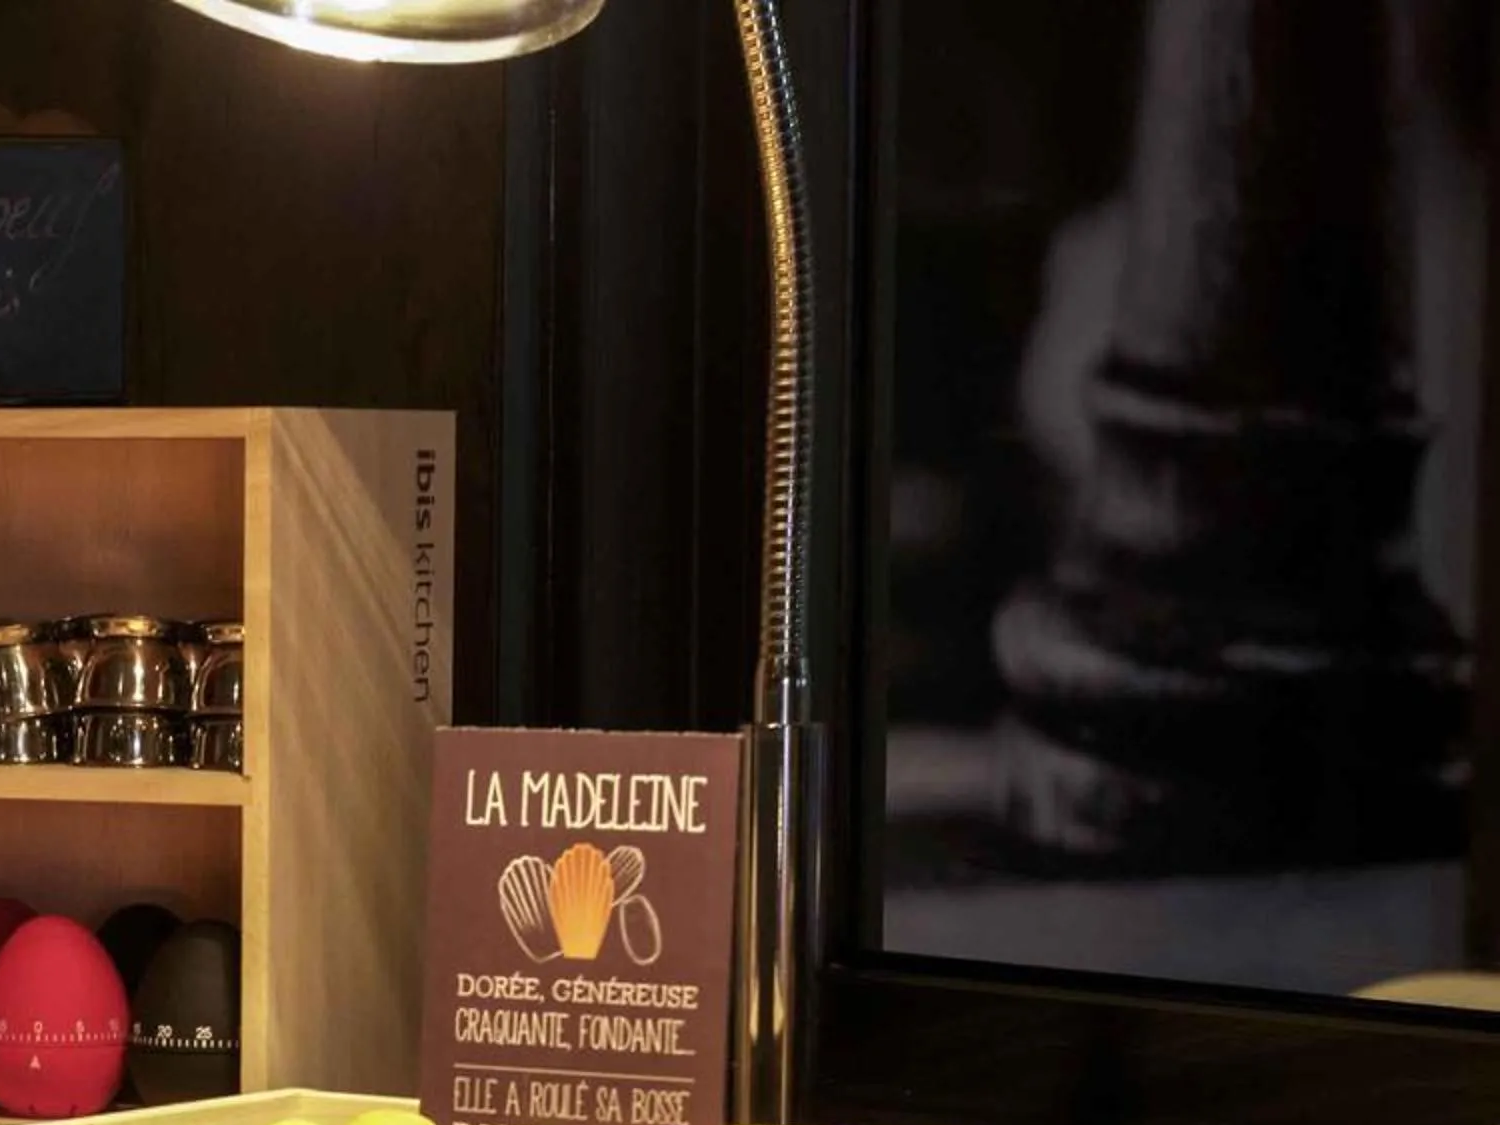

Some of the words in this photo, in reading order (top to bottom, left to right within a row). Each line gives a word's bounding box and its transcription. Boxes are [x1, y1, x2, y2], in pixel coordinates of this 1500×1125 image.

[415, 449, 437, 532] ibis
[413, 543, 436, 703] kitchen
[465, 768, 507, 828] LA
[521, 770, 708, 833] MADELEINE
[457, 973, 545, 1003] DORÉE,
[552, 974, 699, 1009] GÉNÉREUSE
[454, 1007, 572, 1052] CRAQUANTE,
[453, 1076, 498, 1116] ELLE
[505, 1081, 521, 1118] A
[528, 1079, 588, 1122] ROULÉ
[597, 1088, 623, 1123] SA
